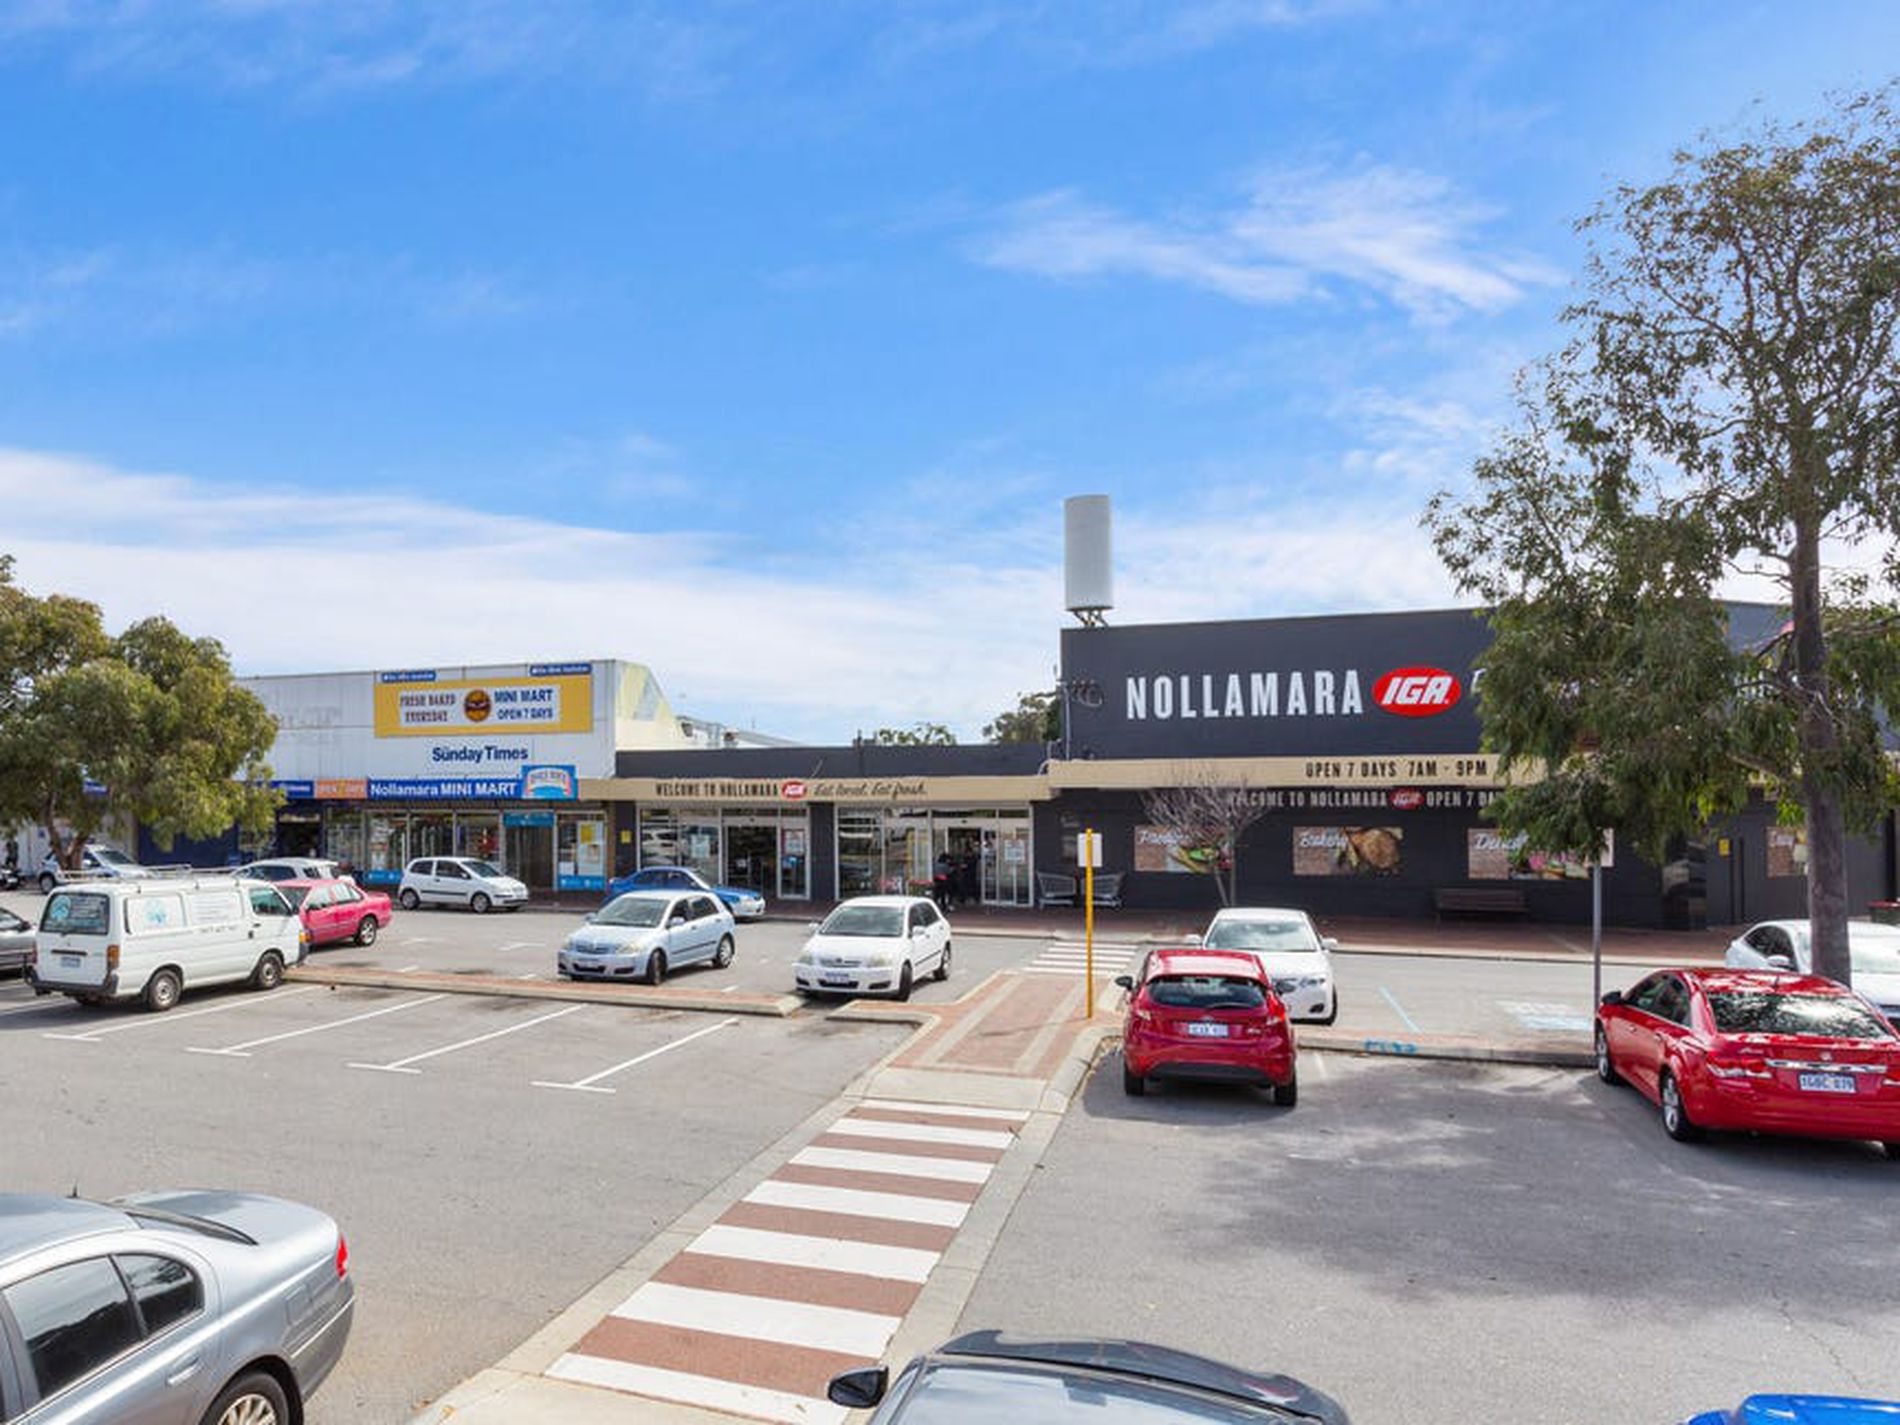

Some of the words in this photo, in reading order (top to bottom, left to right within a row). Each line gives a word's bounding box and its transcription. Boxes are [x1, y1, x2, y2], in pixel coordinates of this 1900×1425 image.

[494, 690, 517, 703] MINI
[520, 689, 553, 702] MART
[1126, 669, 1364, 719] NOLLAMARA
[1380, 675, 1453, 704] IGA
[497, 709, 521, 721] OPEN
[432, 746, 483, 763] Sunday
[484, 745, 528, 760] Times
[1305, 762, 1341, 778] OPEN
[1347, 762, 1354, 777] 7
[1361, 761, 1397, 777] DAYS
[1407, 760, 1438, 777] 7AM
[1456, 760, 1488, 776] 9PM
[370, 782, 439, 797] Nollamara
[440, 782, 472, 796] MINI
[474, 782, 517, 796] MART
[655, 783, 700, 797] WELCOME
[704, 783, 716, 796] TO
[720, 783, 778, 797] NOLLAMARA
[1289, 791, 1304, 807] TO
[1310, 791, 1387, 807] NOLLAMARA
[1427, 790, 1461, 807] OPEN
[1466, 790, 1474, 807] 7
